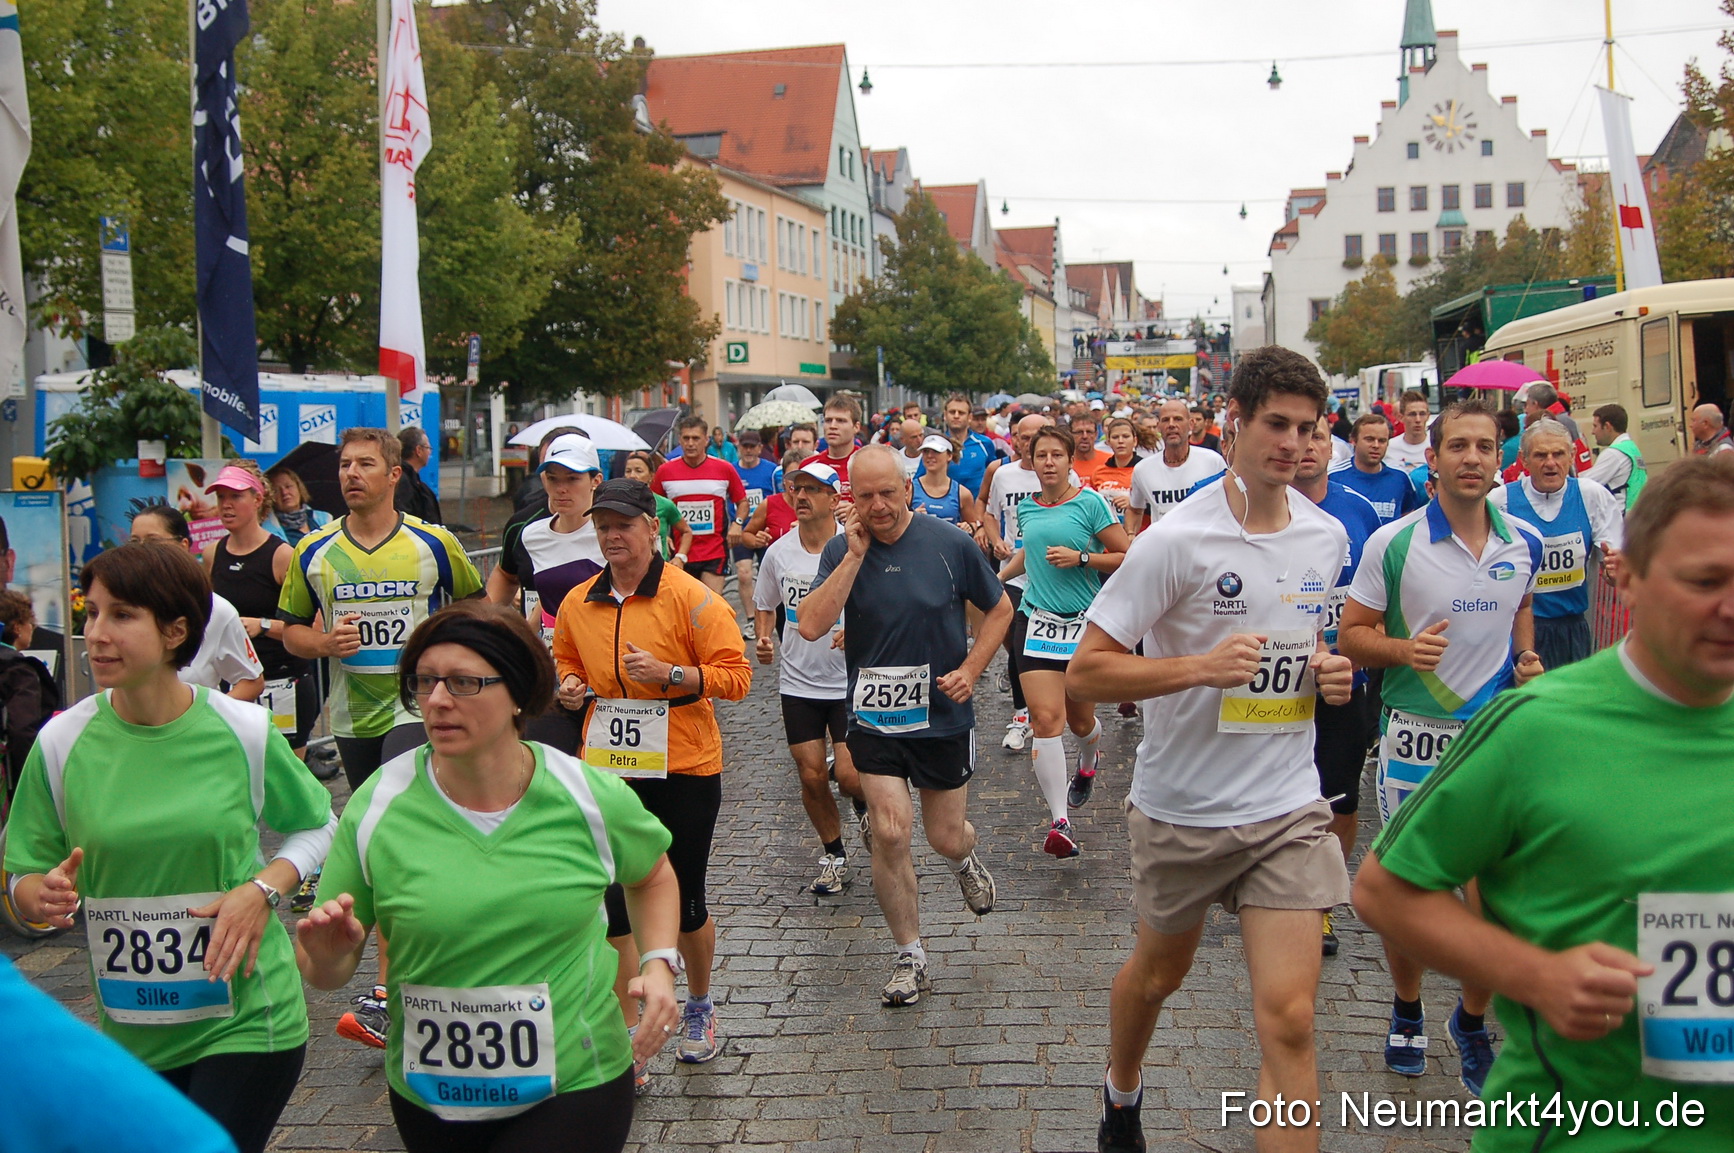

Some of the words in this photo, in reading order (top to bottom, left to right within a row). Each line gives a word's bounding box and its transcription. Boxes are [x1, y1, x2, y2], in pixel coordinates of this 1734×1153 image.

[729, 344, 745, 361] D
[748, 495, 760, 506] 90
[682, 509, 711, 522] 2249
[1545, 540, 1574, 549] Neumarkt
[1537, 574, 1571, 585] Gerwald
[334, 581, 419, 600] BOCK
[788, 586, 808, 607] 25
[1213, 600, 1247, 609] PARTL
[1452, 599, 1498, 613] Stefan
[361, 609, 398, 617] Neumarkt
[357, 619, 407, 646] 062
[1033, 620, 1082, 640] 2817
[1041, 643, 1068, 652] Andrea
[1273, 640, 1311, 650] Neumarkt
[883, 673, 917, 681] Neumarkt
[1249, 655, 1309, 693] 567
[862, 682, 922, 708] 2524
[596, 704, 613, 713] PARTL
[614, 706, 653, 715] Neumarkt
[1245, 701, 1307, 718] Kordula
[878, 714, 907, 724] Armin
[609, 717, 641, 747] 95
[610, 753, 637, 766] Petra
[88, 909, 130, 922] PARTL
[133, 907, 195, 922] Neumark
[1643, 913, 1711, 929] PARTL
[103, 925, 213, 975] 2834
[1661, 939, 1734, 1008] 28
[136, 987, 180, 1006] Silke
[404, 996, 447, 1013] PARTL
[451, 1000, 523, 1014] Neumarkt
[417, 1018, 539, 1070] 2830
[438, 1081, 519, 1103] Gabriele
